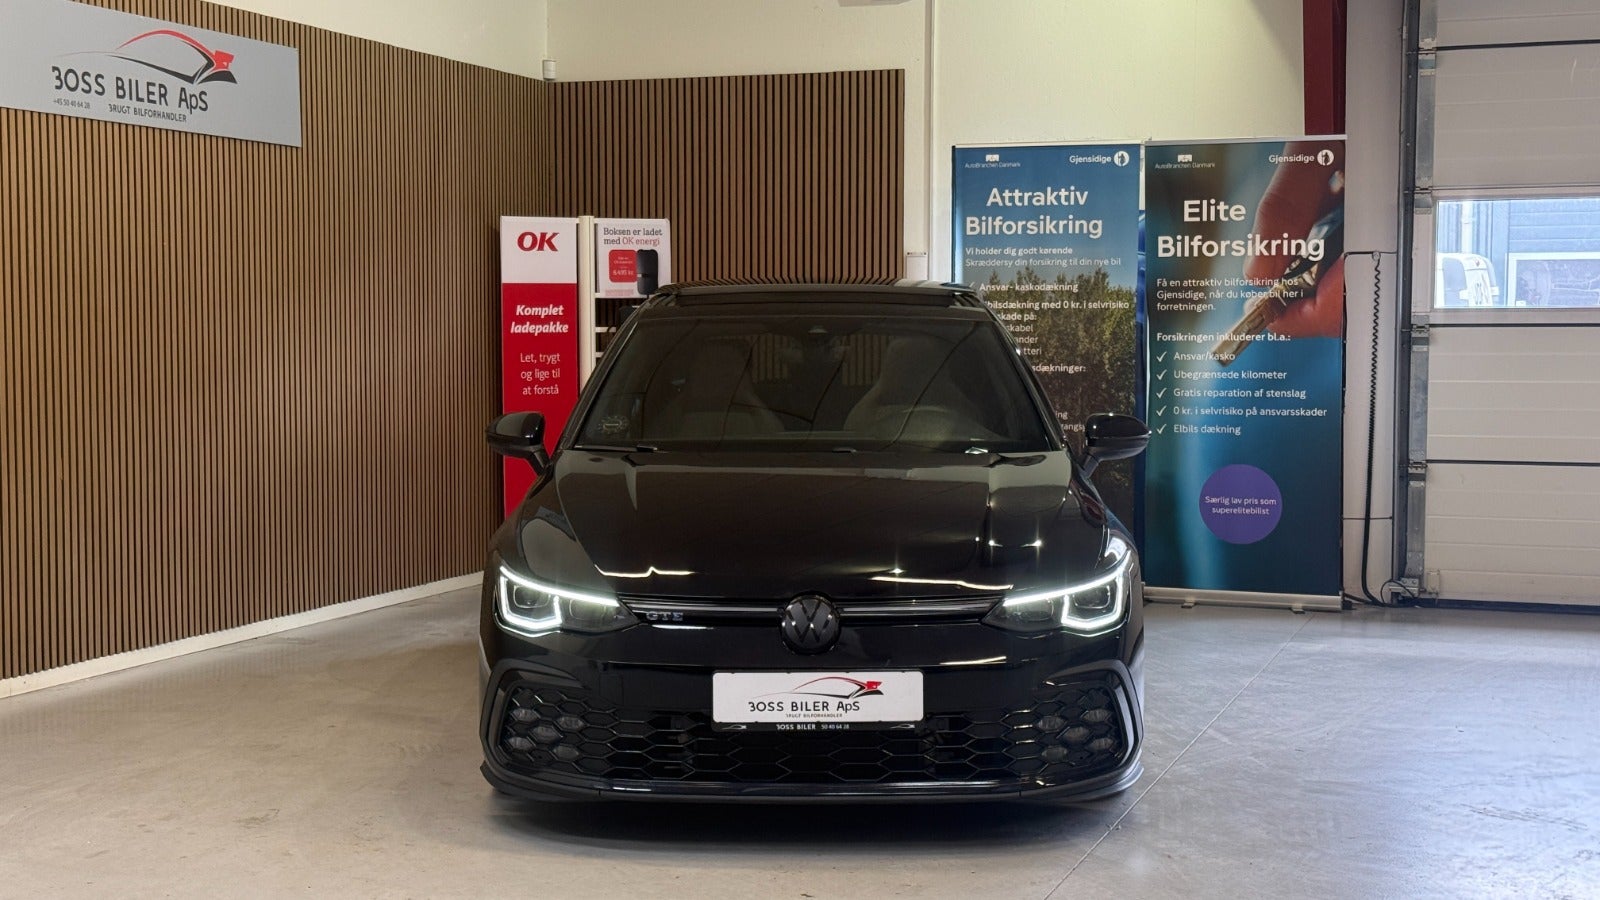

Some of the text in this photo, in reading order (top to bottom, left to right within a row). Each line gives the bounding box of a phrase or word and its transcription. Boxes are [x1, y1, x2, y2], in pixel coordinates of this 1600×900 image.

[116, 77, 168, 107] BILER
[178, 87, 208, 114] ApS
[134, 107, 187, 122] BILFORHANDLER
[1069, 155, 1111, 164] Gjensidige
[1269, 155, 1314, 165] Gjensidige
[986, 186, 1088, 206] Attraktiv
[1183, 198, 1246, 222] Elite
[604, 227, 631, 236] Boksen
[643, 228, 662, 236] ladet
[966, 215, 1102, 239] Bilforsikring
[517, 231, 559, 251] OK
[604, 237, 660, 247] med OK energi
[1004, 247, 1016, 256] dig
[1018, 247, 1037, 256] godt
[1158, 233, 1325, 261] Bilforsikring
[966, 259, 1012, 267] Skræddersy
[1029, 258, 1067, 267] forsikring
[1094, 259, 1108, 267] nye
[1016, 282, 1078, 293] kaskodækning
[1157, 278, 1167, 287] Få
[1182, 278, 1222, 287] attraktiv
[1224, 278, 1279, 287] bilforsikring
[1282, 278, 1298, 286] hos
[1157, 291, 1207, 300] Gjensidige,
[1209, 290, 1224, 298] når
[1226, 290, 1238, 298] du
[1240, 290, 1267, 298] køber
[1269, 290, 1280, 298] bil
[1283, 290, 1298, 298] her
[984, 301, 1039, 310] bilsdækning
[1041, 301, 1062, 309] med
[1063, 301, 1068, 309] 0
[1071, 301, 1082, 309] kr.
[1088, 300, 1129, 309] selvrisiko
[1157, 302, 1216, 312] forretningen.
[516, 305, 564, 318] Komplet
[1024, 312, 1037, 322] på:
[510, 322, 569, 336] ladepakke
[1157, 333, 1291, 342] Forsikringen inkluderer bl.a.:
[1023, 347, 1042, 355] tteri
[520, 353, 560, 365] Let, trygt
[1173, 352, 1235, 361] Ansvar/kasko
[1032, 364, 1086, 374] sdækninger:
[520, 368, 560, 381] og lige til
[1173, 370, 1287, 380] Ubegrænsede kilometer
[522, 384, 559, 395] at forstå
[1173, 389, 1306, 399] Gratis reparation af stenslag
[1173, 407, 1179, 415] 0
[1182, 407, 1193, 415] kr.
[1201, 407, 1243, 415] selvrisiko
[1246, 407, 1257, 417] på
[1260, 407, 1327, 416] ansvarsskader
[1173, 425, 1241, 435] Elbils dækning
[1205, 496, 1230, 505] Særlig
[1244, 497, 1258, 505] pris
[1212, 507, 1269, 515] superelitebilist
[646, 611, 684, 621] GTE
[791, 701, 829, 711] BILER
[837, 701, 860, 713] ApS
